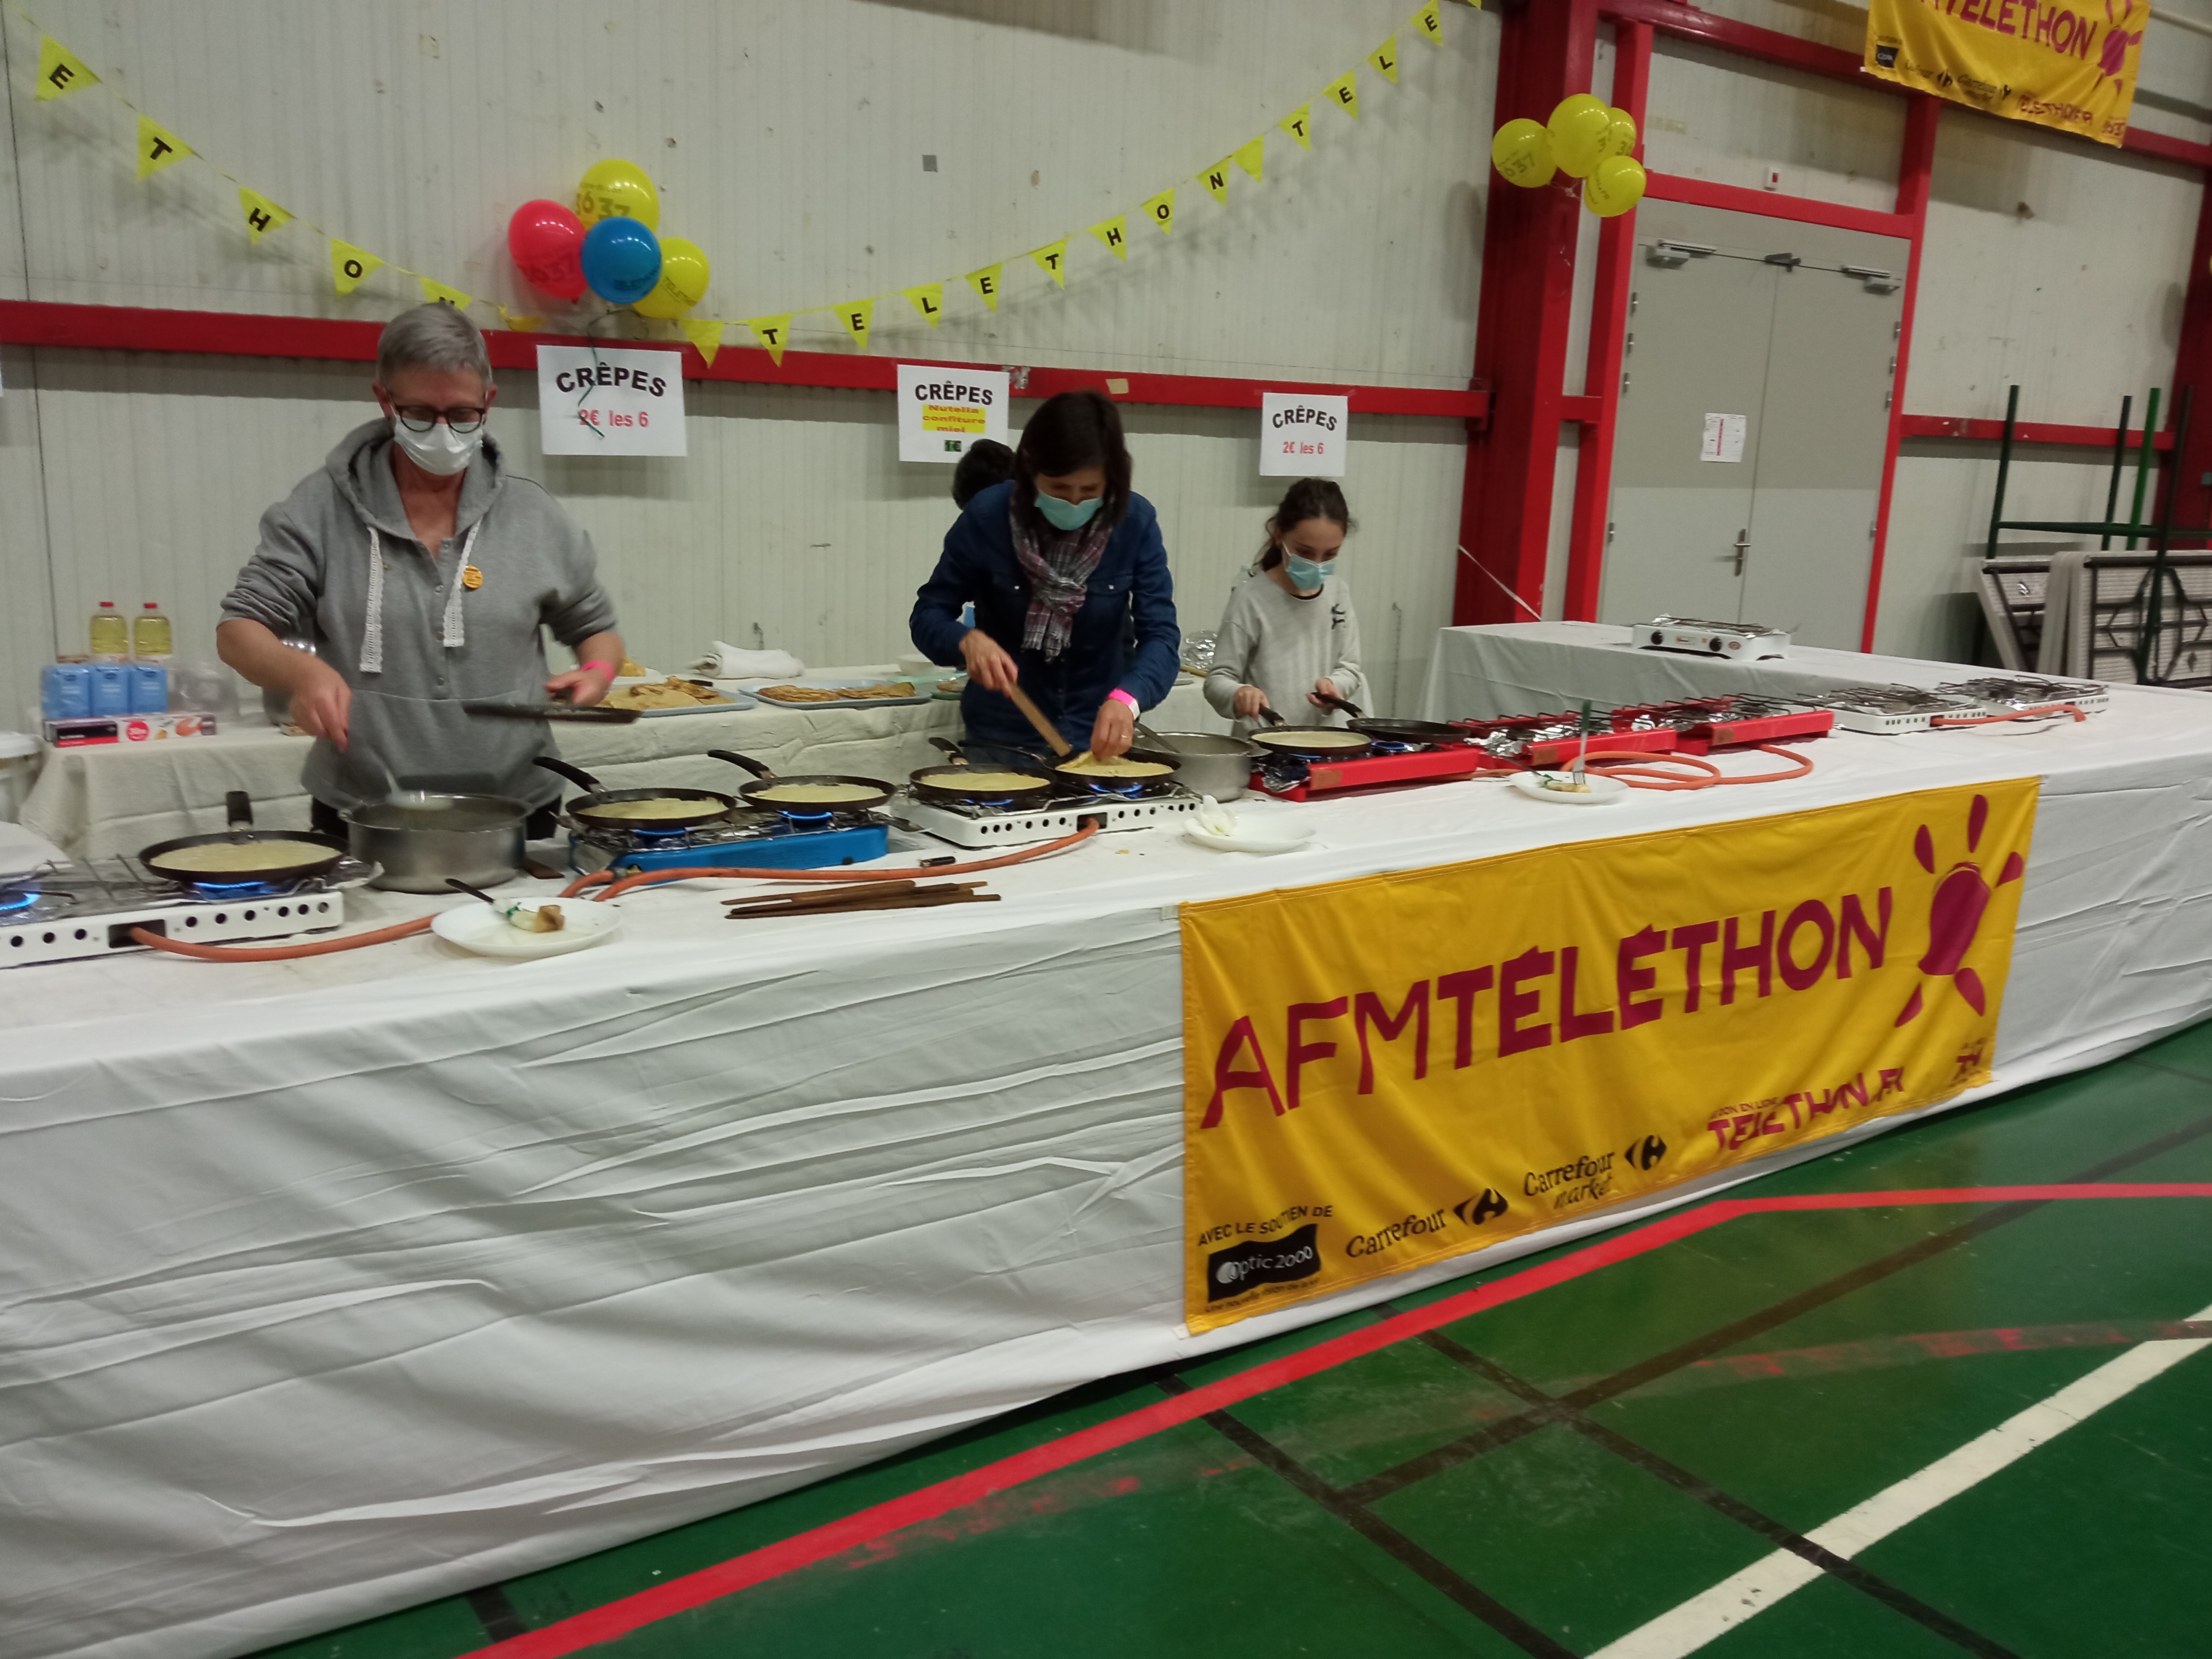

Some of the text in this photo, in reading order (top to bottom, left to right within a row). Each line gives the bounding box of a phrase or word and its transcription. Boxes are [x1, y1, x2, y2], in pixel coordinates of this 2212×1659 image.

[556, 362, 667, 397] CRÊPES
[915, 380, 993, 405] CRÊPES
[609, 410, 633, 427] les
[639, 411, 649, 428] 6
[923, 415, 986, 424] confiture
[929, 405, 979, 414] Nutella
[1272, 405, 1337, 431] CRÊPES
[1283, 441, 1325, 455] 2€ les 6
[1524, 1151, 1615, 1197] Carrefour
[1198, 1205, 1333, 1246] AVEC LE SOUTEN DE
[1346, 1209, 1446, 1258] Carrefour
[1274, 1246, 1313, 1268] 2000
